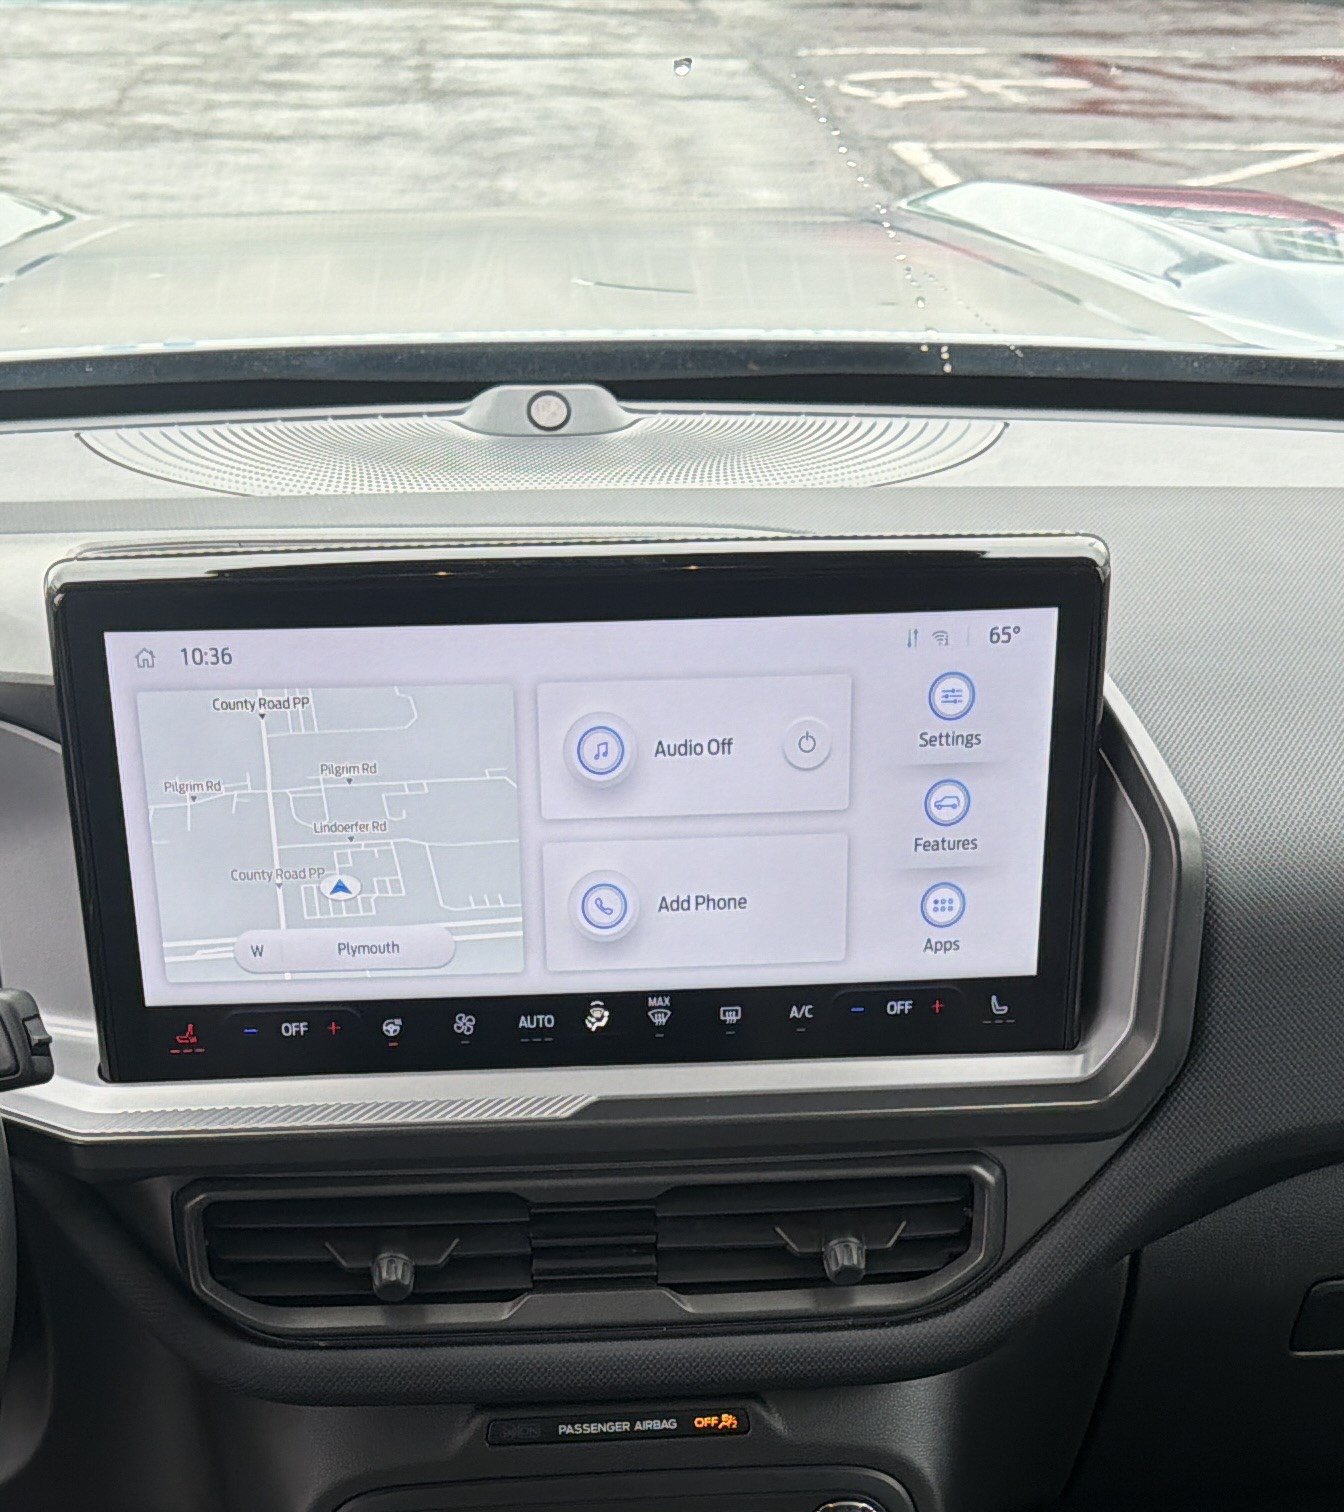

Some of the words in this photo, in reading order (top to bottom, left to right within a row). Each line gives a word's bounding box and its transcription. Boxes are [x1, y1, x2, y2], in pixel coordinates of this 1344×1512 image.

[988, 626, 1021, 645] 65°
[179, 646, 234, 667] 10:36
[212, 697, 256, 712] County
[258, 696, 290, 711] Road
[292, 695, 311, 710] PP
[654, 738, 704, 757] Audio
[707, 737, 734, 757] Off
[918, 730, 983, 750] Settings
[320, 762, 358, 779] Pilgrim
[361, 761, 378, 776] Rd
[163, 780, 202, 795] Pilgrim
[204, 779, 223, 793] Rd
[313, 821, 370, 834] Lindoerfer
[371, 820, 387, 833] Rd
[913, 836, 978, 853] Features
[230, 868, 273, 883] County
[275, 867, 305, 881] Road
[308, 867, 326, 881] PP
[657, 895, 691, 912] Add
[694, 894, 748, 912] Phone
[250, 944, 265, 959] W
[337, 940, 401, 958] Plymouth
[923, 937, 961, 955] Apps
[647, 996, 671, 1008] MAX
[886, 1000, 914, 1016] OFF
[789, 1003, 814, 1021] A/C
[281, 1021, 309, 1038] OFF
[518, 1014, 556, 1030] AUTO
[558, 1419, 631, 1436] PASSENGER
[634, 1416, 678, 1434] AIRBAG
[693, 1415, 719, 1430] OFF
